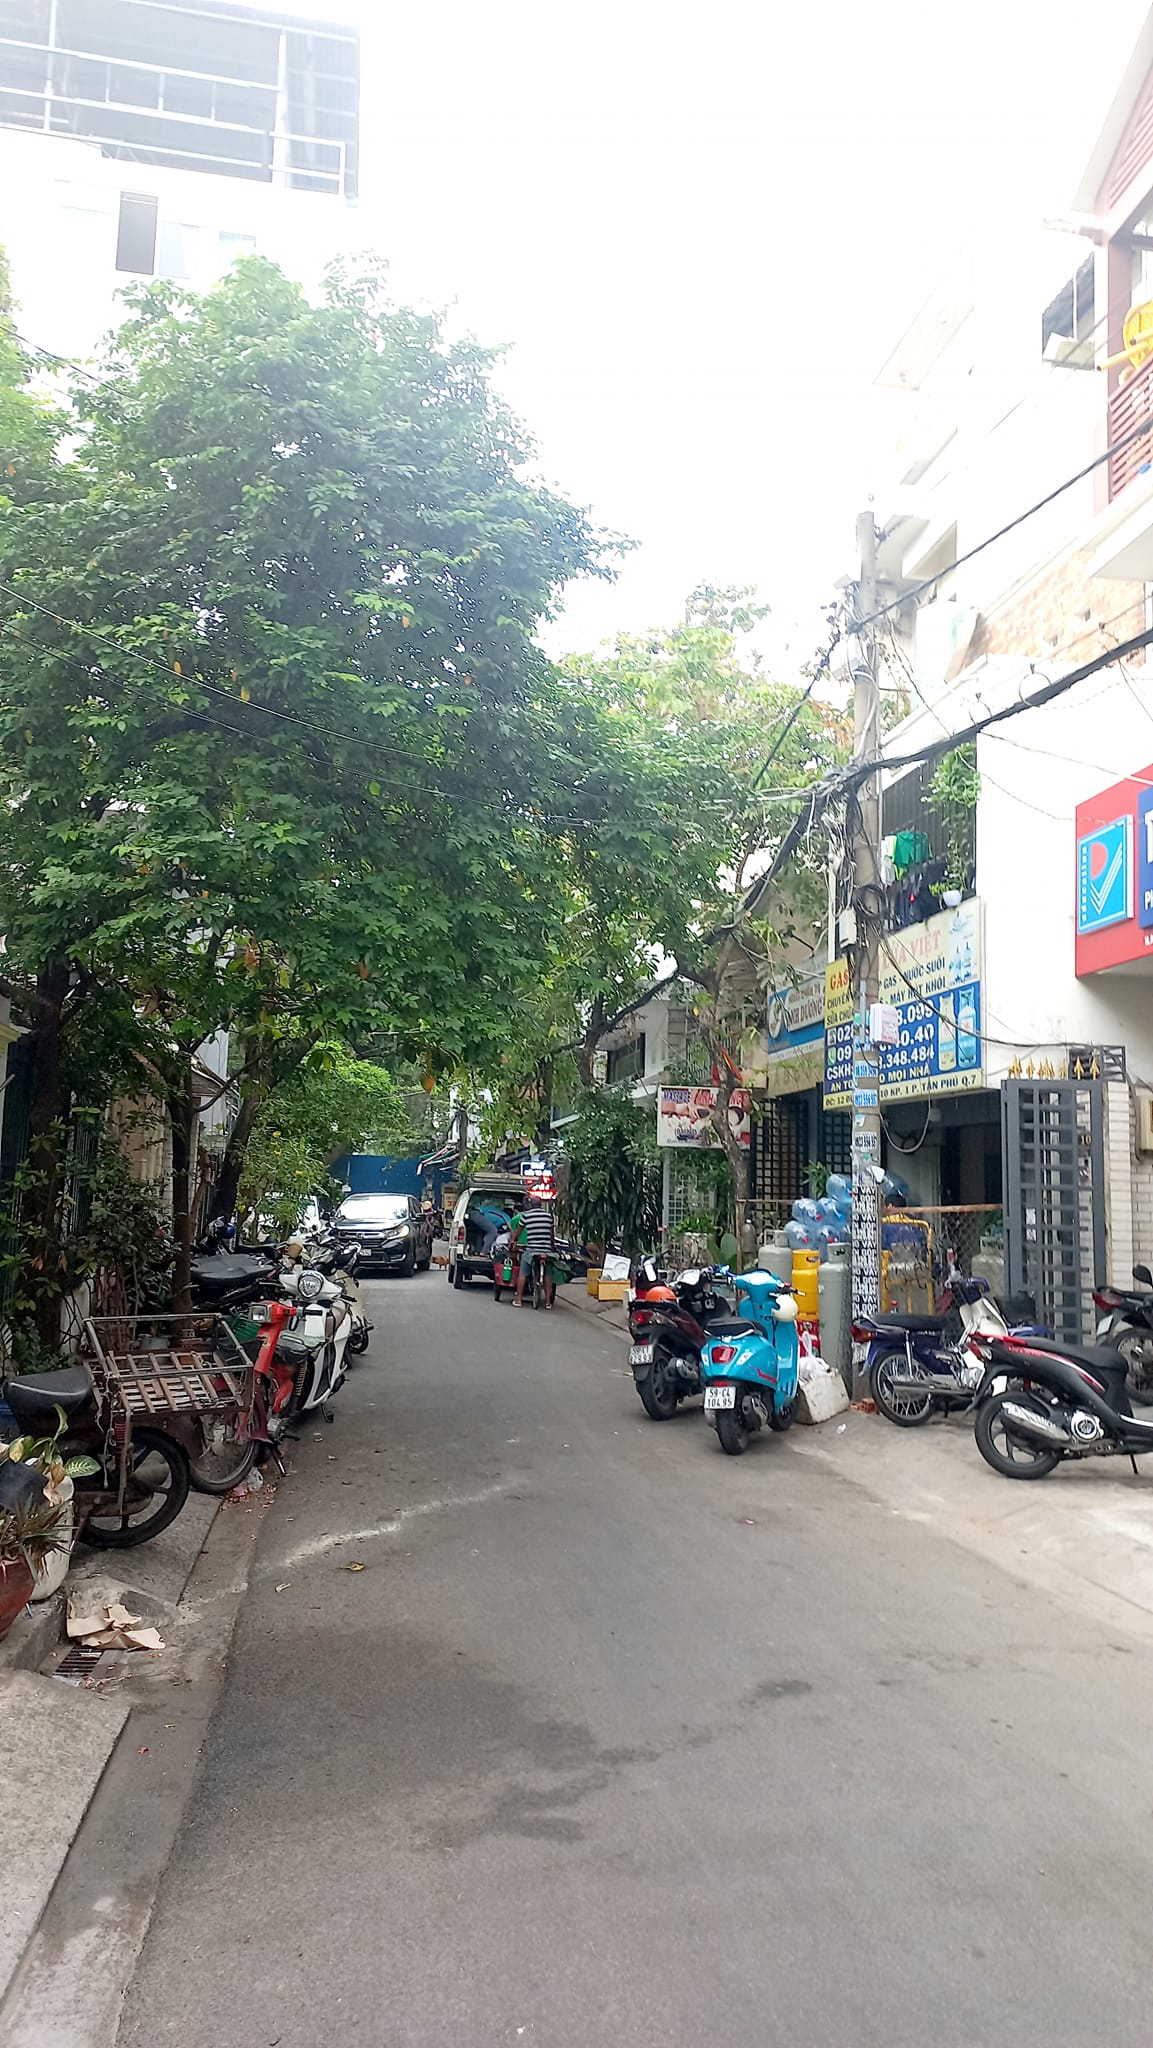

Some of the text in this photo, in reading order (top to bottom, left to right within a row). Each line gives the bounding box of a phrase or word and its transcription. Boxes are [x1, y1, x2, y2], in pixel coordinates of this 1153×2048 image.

[830, 969, 850, 990] GAS
[883, 974, 897, 989] GAS
[961, 1074, 977, 1087] Q.7
